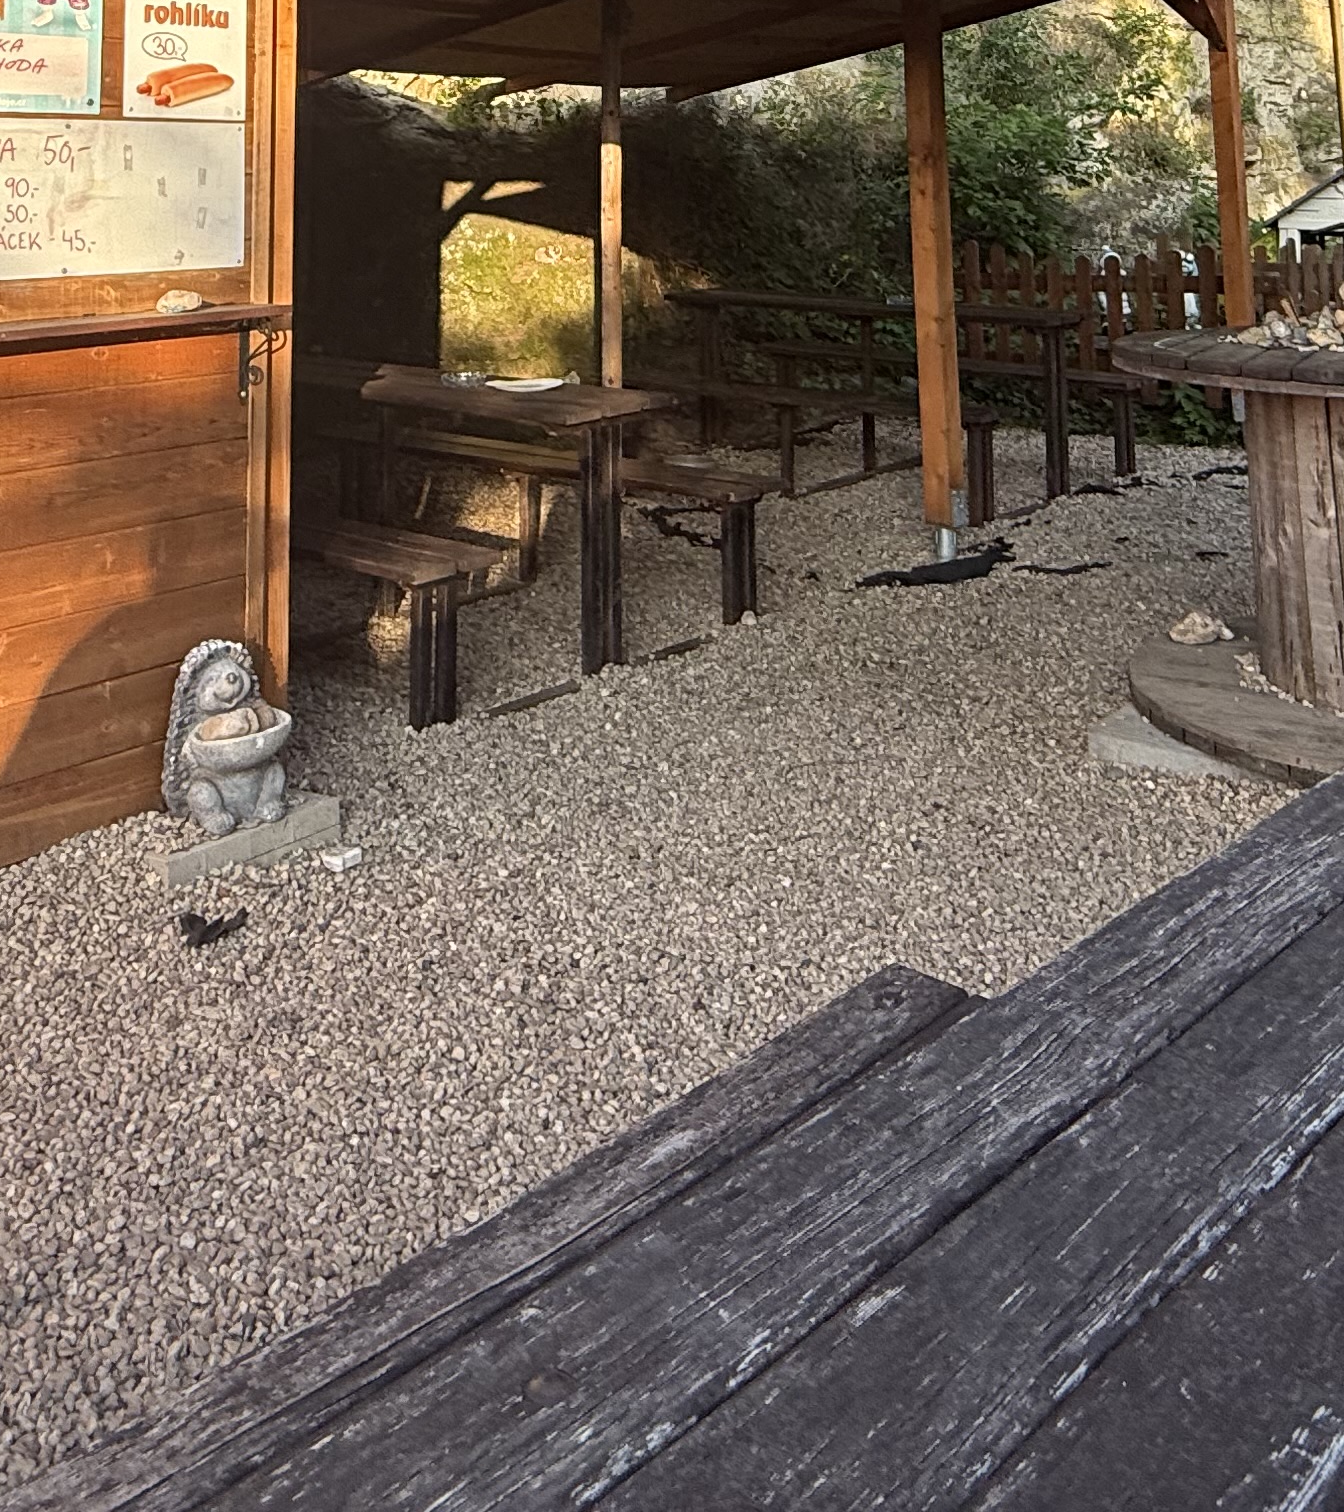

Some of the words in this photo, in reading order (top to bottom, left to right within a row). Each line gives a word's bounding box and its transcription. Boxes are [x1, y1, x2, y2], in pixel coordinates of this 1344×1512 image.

[143, 0, 230, 30] rohlíku
[43, 134, 92, 172] 50,-
[4, 177, 40, 199] 90,-
[3, 204, 39, 224] 50,-
[61, 229, 97, 254] 45,-
